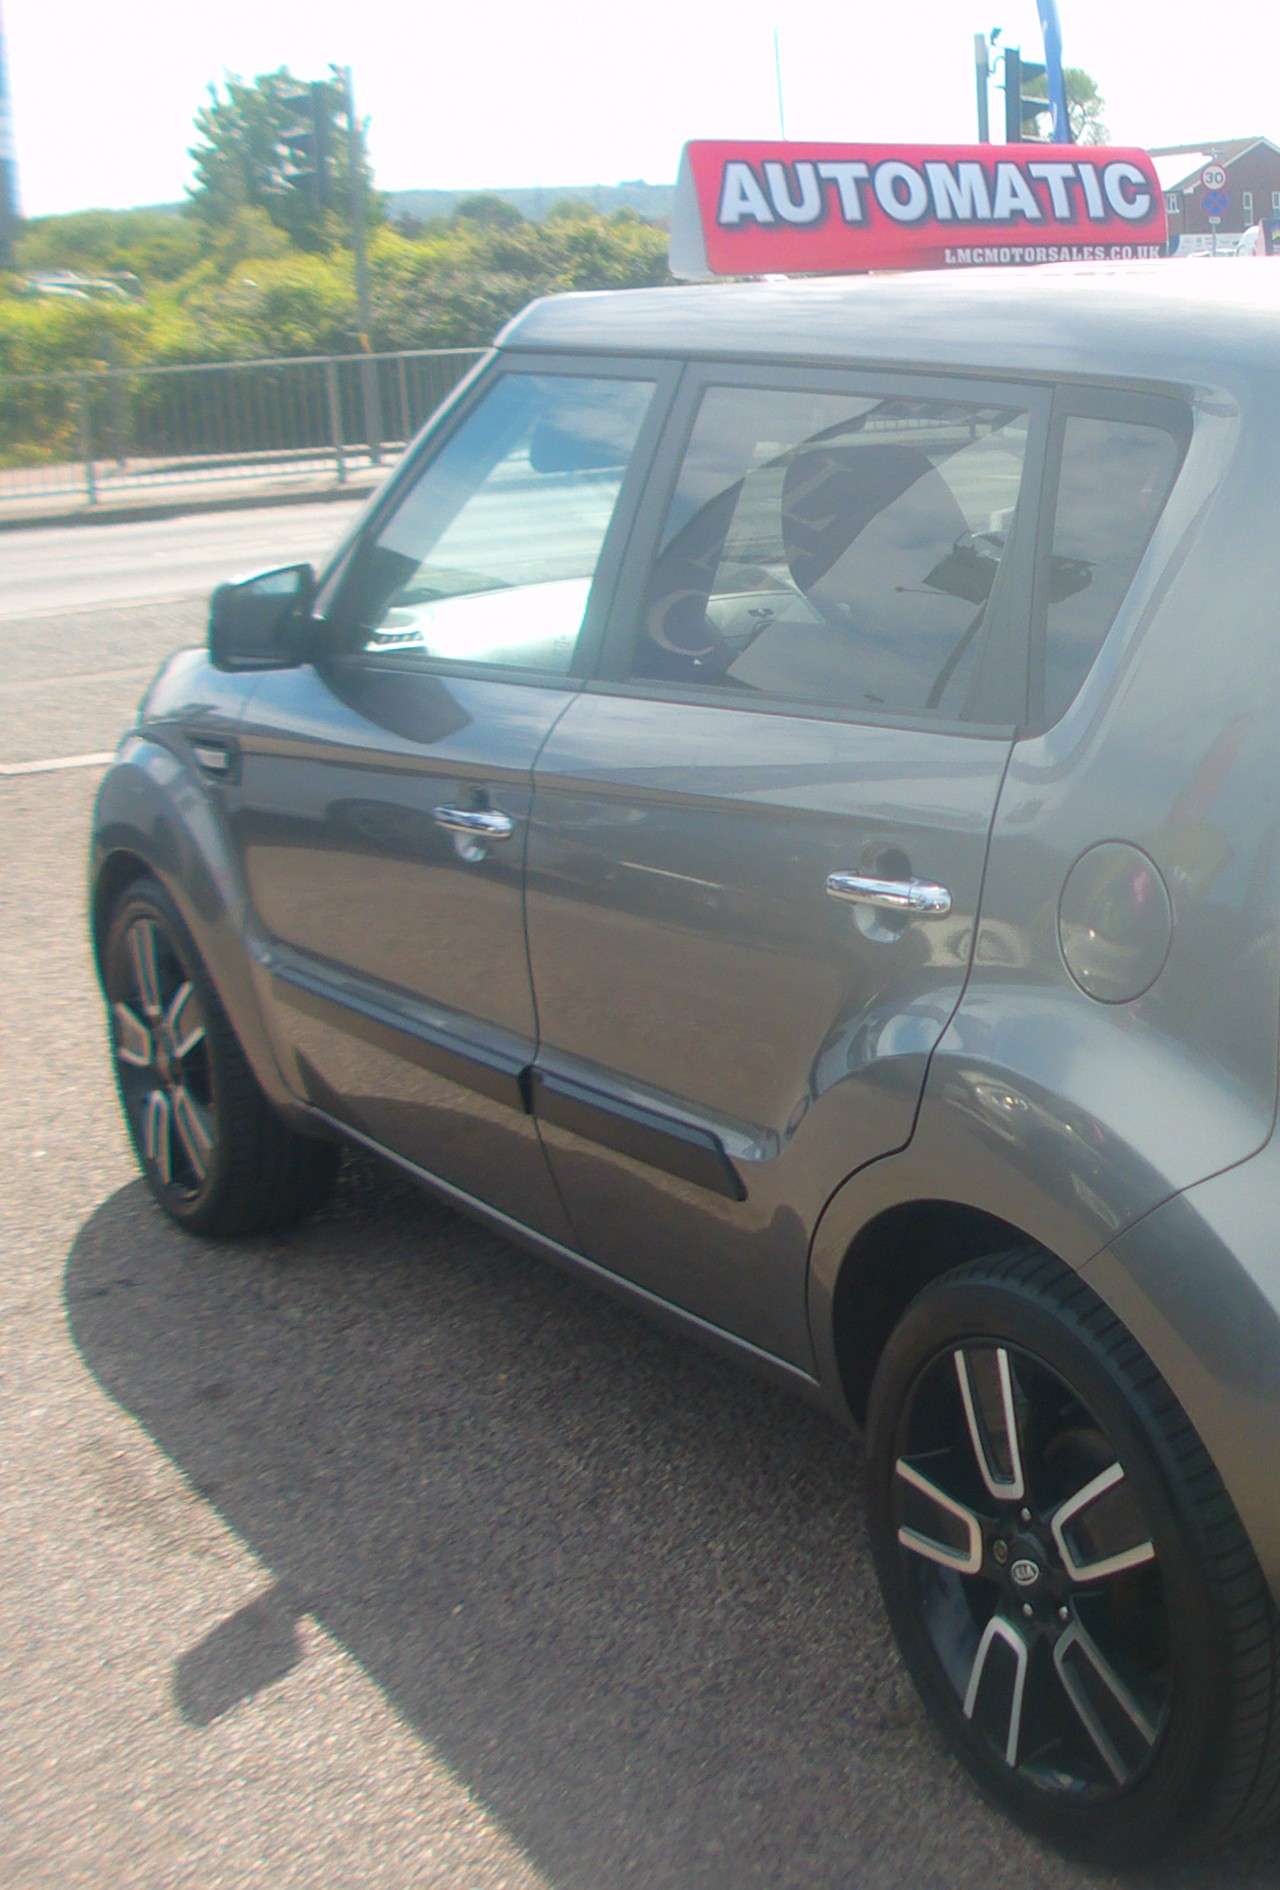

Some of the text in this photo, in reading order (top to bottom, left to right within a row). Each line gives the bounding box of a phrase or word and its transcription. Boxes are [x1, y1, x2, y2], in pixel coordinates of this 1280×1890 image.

[1205, 171, 1224, 184] 30
[717, 160, 1153, 226] AUTOMATIC
[944, 244, 1161, 265] LMCMOTORSALES.CO.UK
